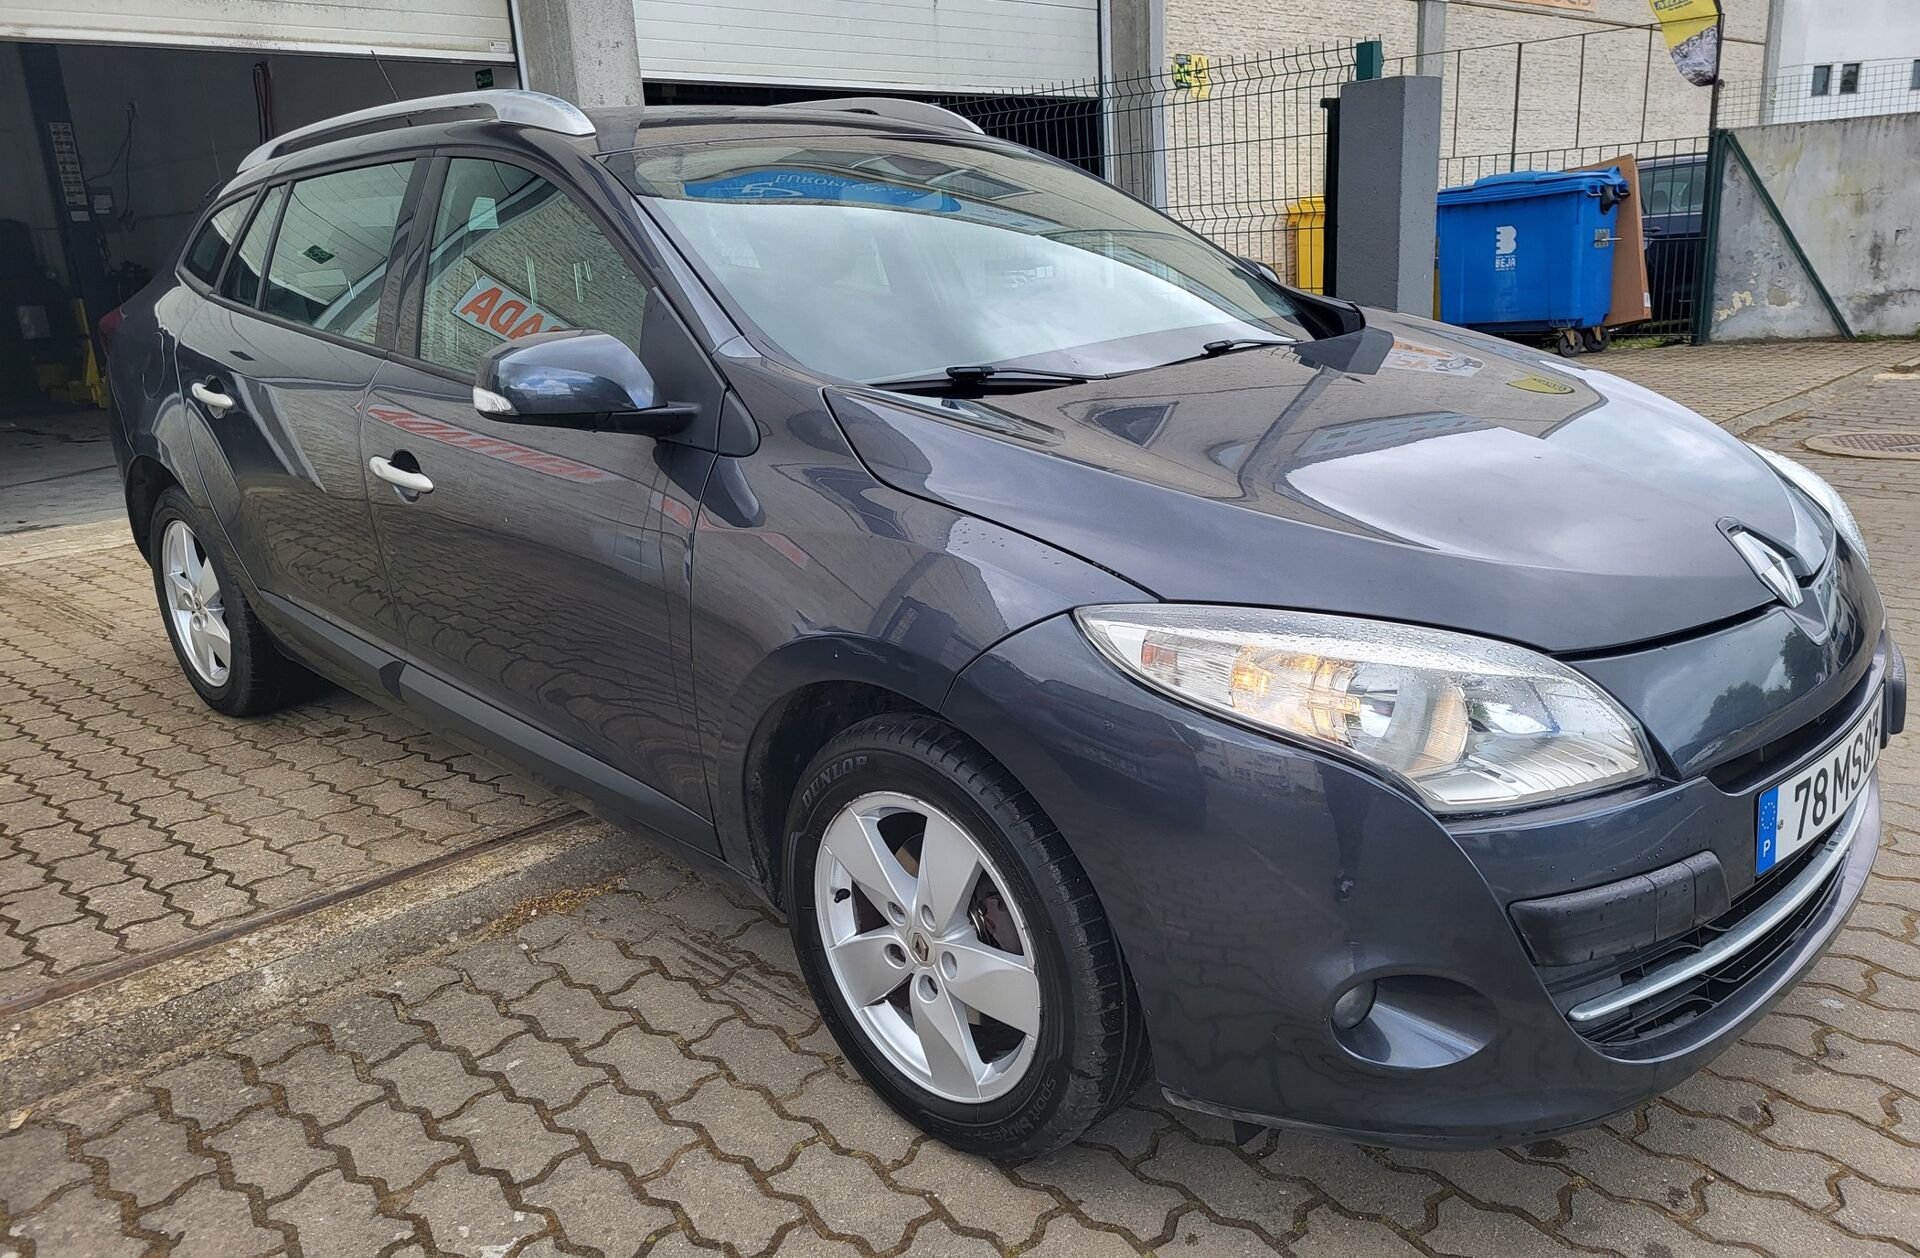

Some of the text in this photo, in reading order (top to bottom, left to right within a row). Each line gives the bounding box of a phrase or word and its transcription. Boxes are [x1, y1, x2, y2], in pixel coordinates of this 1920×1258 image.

[1495, 258, 1516, 268] BEJA
[801, 755, 868, 808] DUNLOP
[1762, 839, 1772, 858] P
